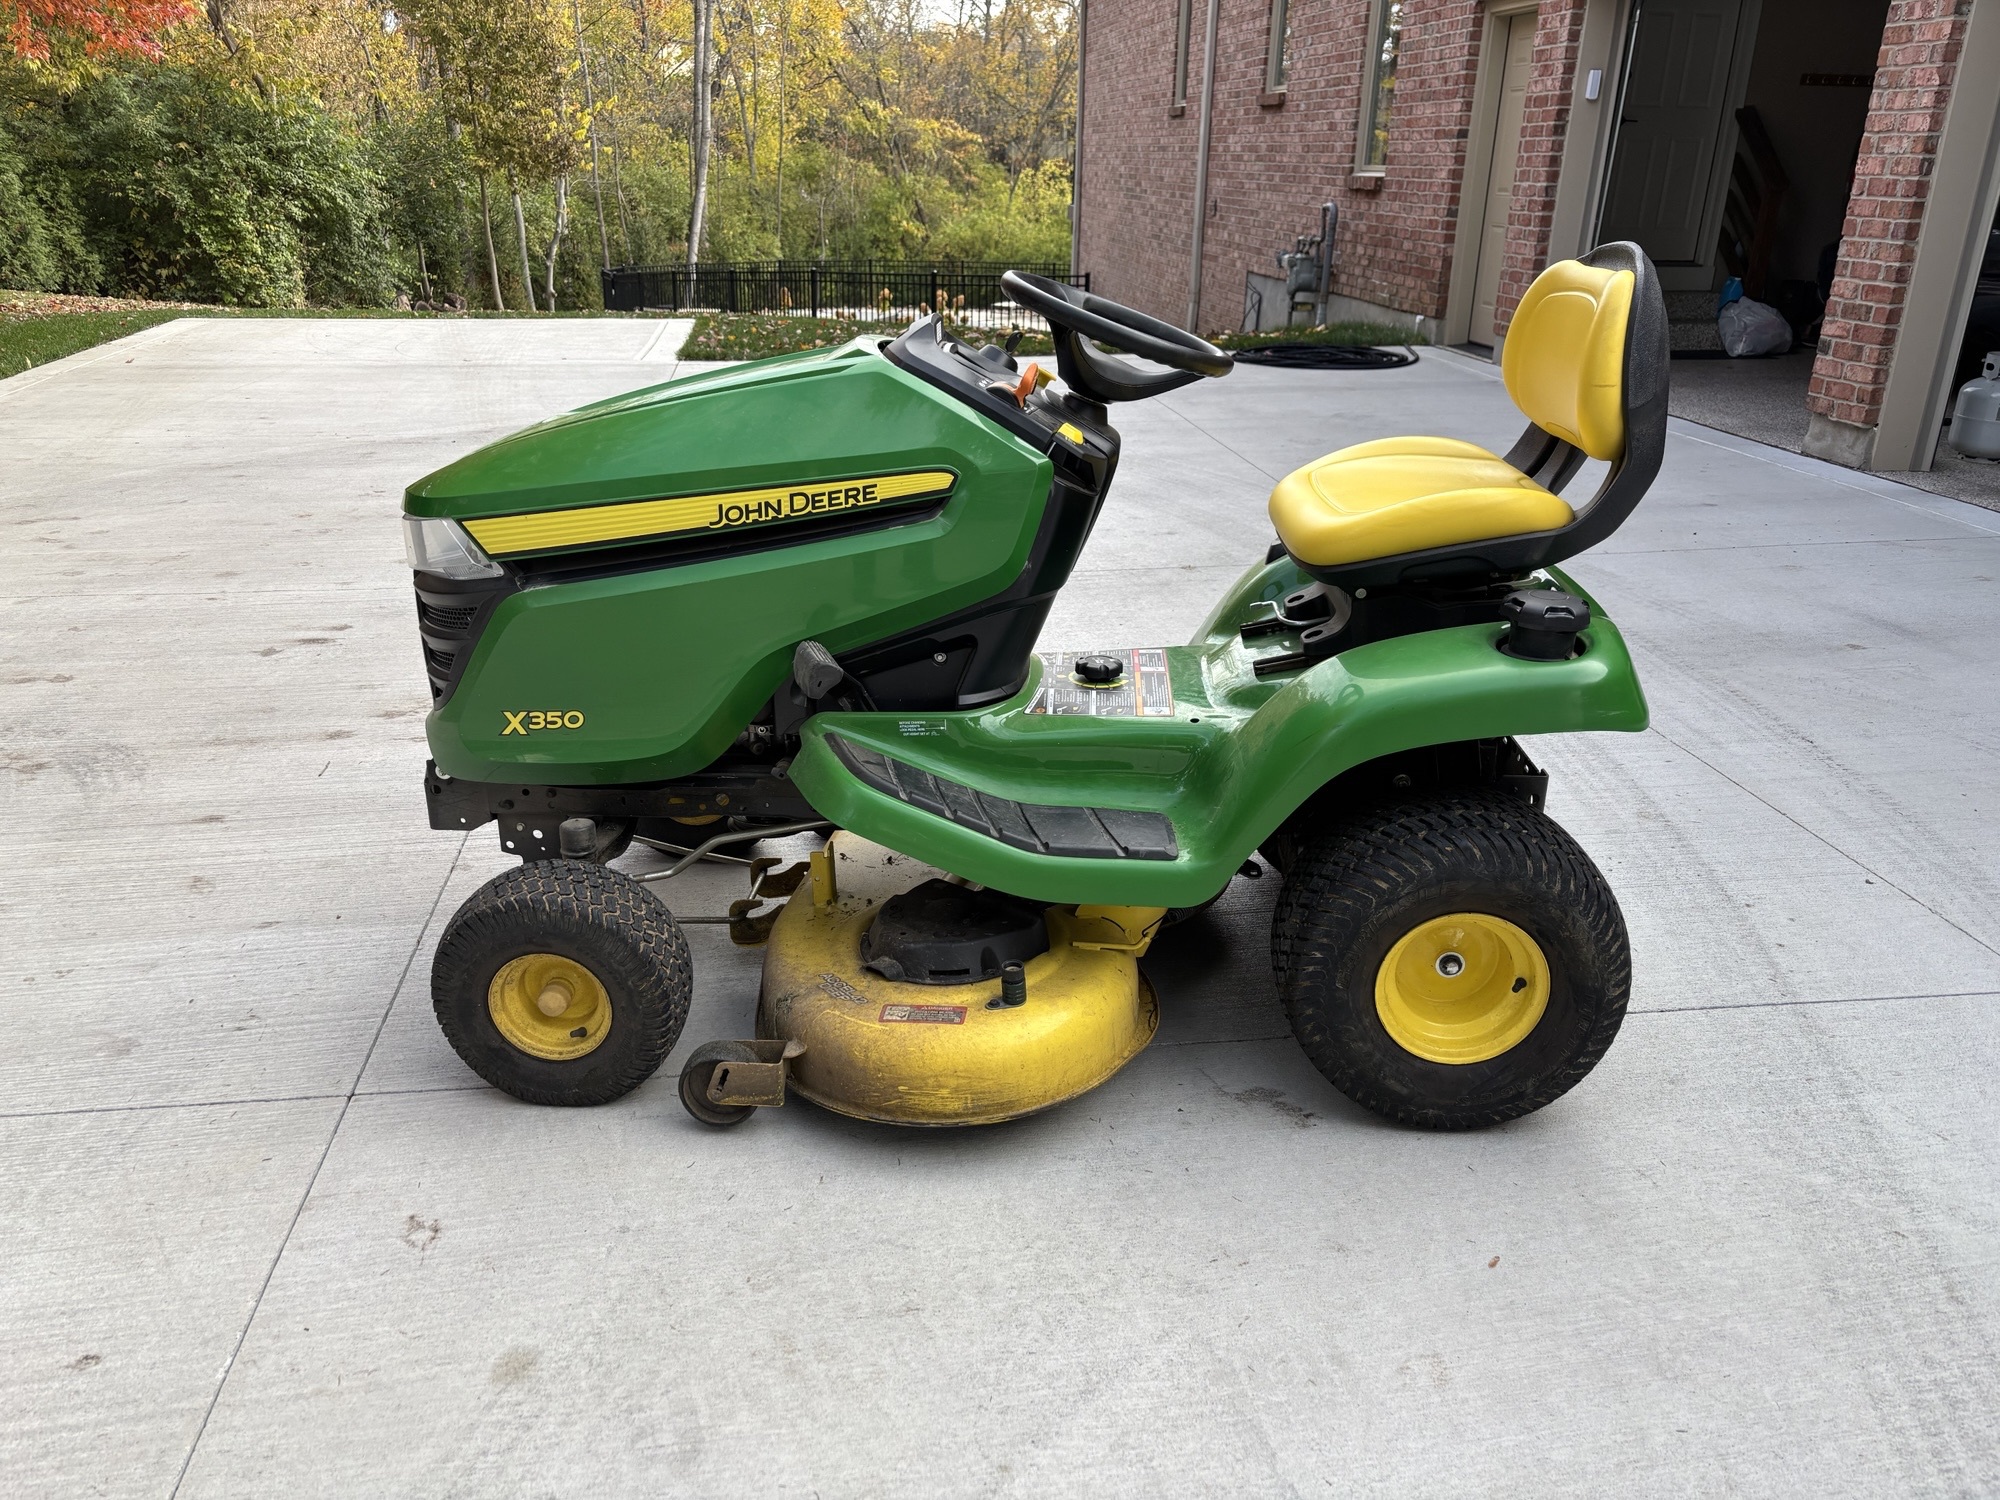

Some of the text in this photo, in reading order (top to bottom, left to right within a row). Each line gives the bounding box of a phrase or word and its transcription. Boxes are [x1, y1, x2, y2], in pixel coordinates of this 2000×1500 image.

[709, 483, 879, 527] JOHN DEERE
[499, 709, 586, 736] X350
[818, 982, 851, 1000] DEEP
[819, 973, 857, 998] ACCEL
